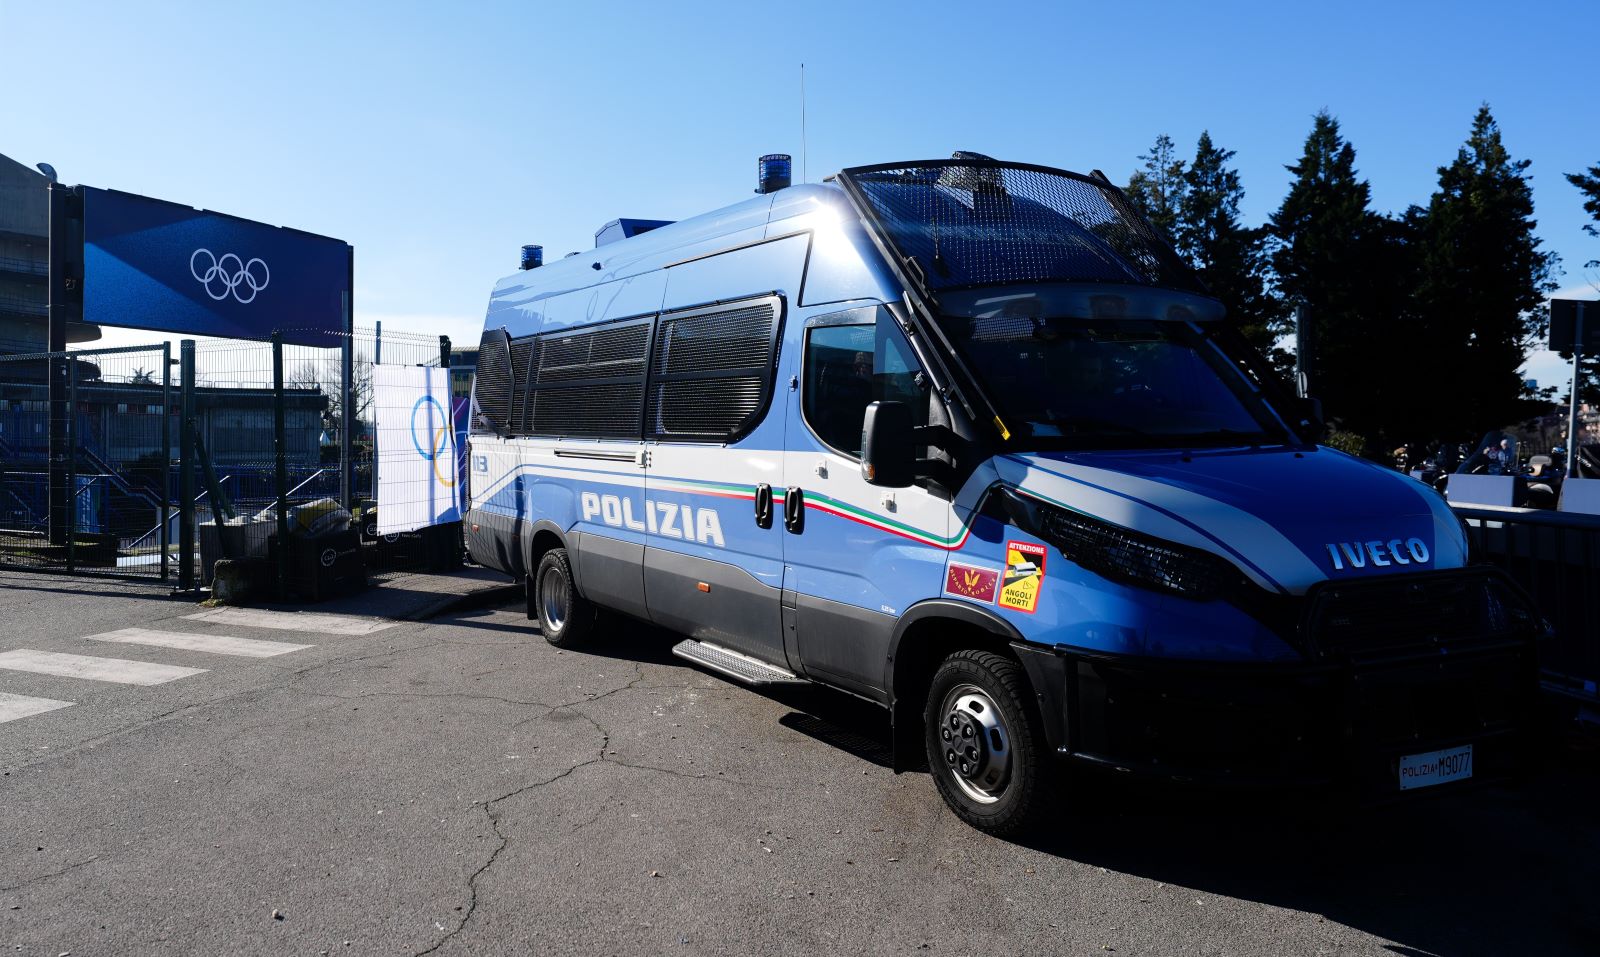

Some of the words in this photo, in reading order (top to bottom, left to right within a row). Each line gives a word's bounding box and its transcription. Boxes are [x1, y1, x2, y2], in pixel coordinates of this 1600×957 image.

[580, 491, 726, 548] POLIZIA
[1009, 542, 1044, 554] ATTENZIONE
[1325, 537, 1431, 571] IVECO
[1005, 589, 1031, 600] ANGOLI
[1006, 596, 1028, 607] MORTI
[1402, 763, 1435, 777] POLIZIA
[1438, 751, 1471, 777] M9077
